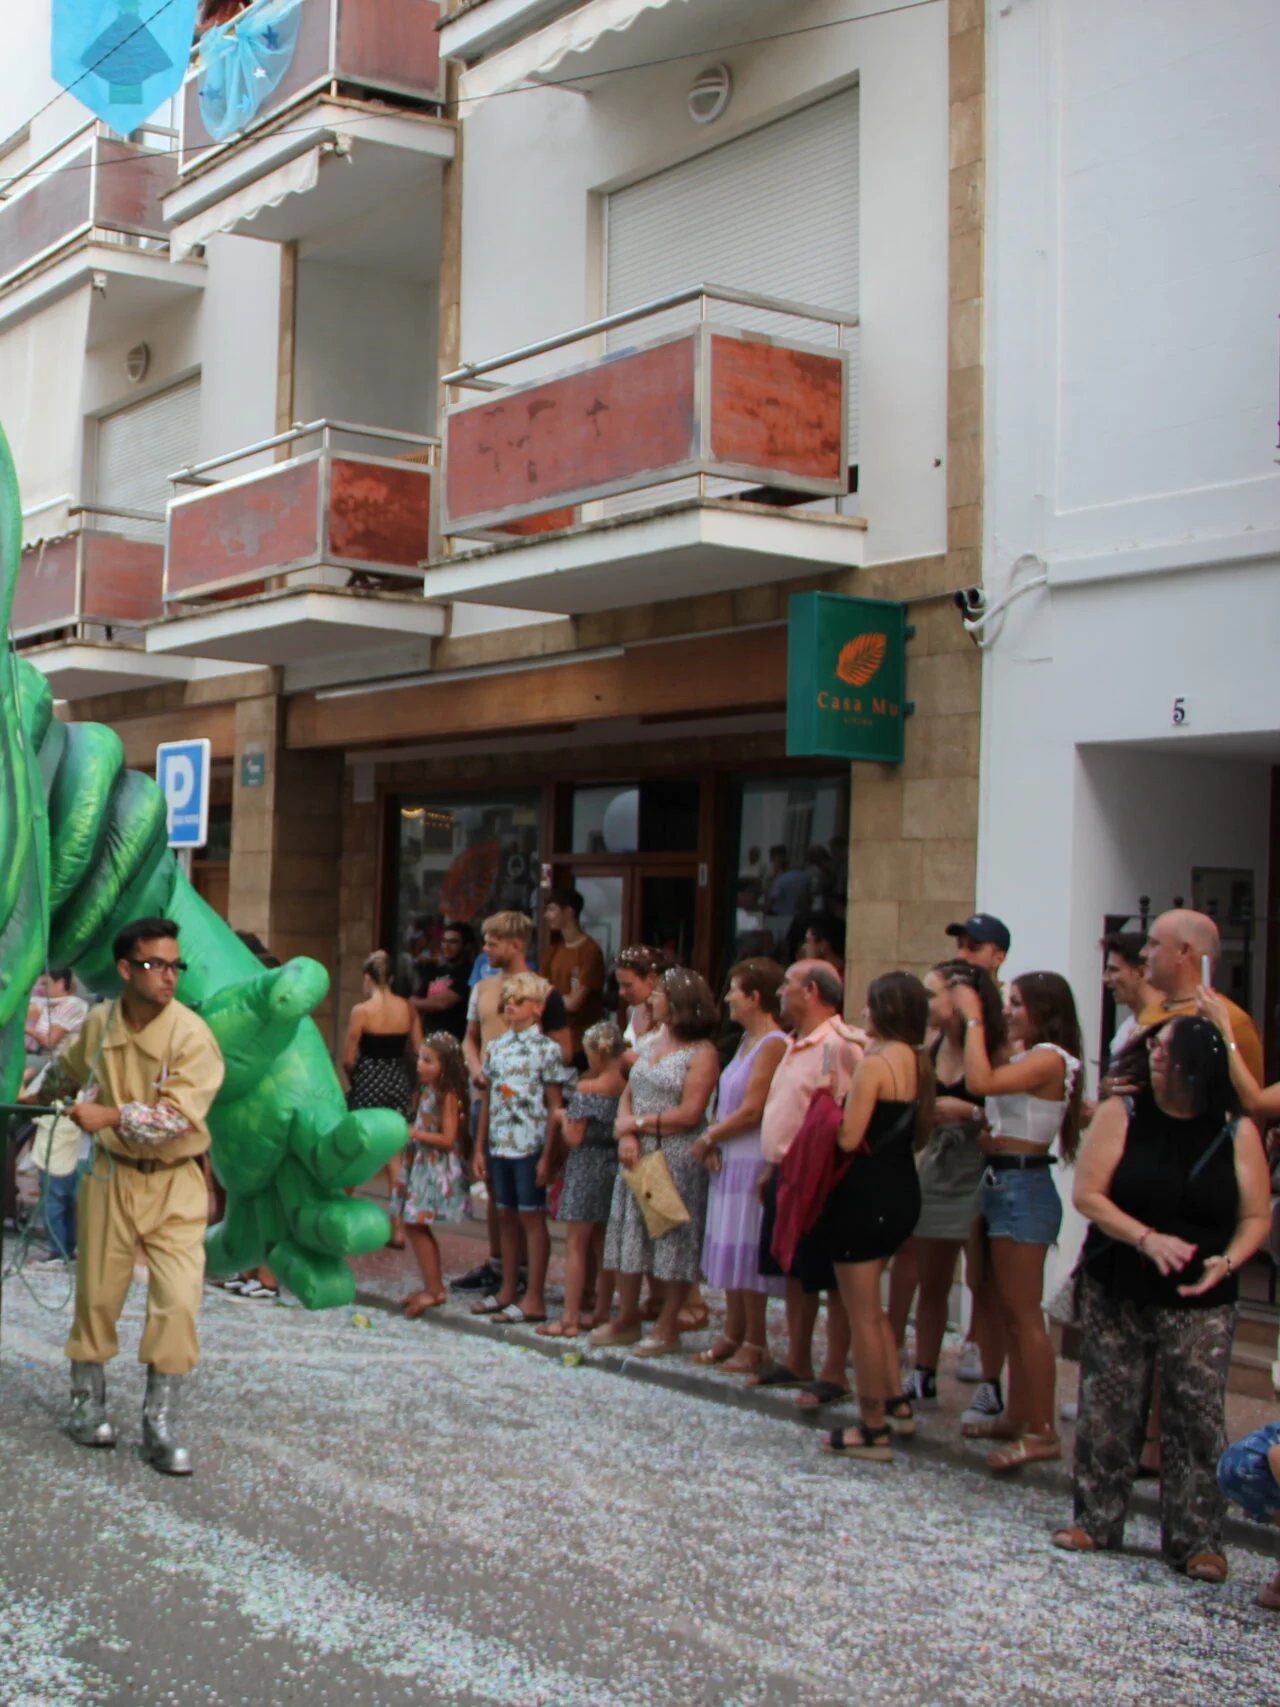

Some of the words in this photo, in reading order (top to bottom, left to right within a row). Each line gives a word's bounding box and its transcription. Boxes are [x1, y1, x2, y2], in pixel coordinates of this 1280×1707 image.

[817, 690, 862, 713] Casa
[1173, 698, 1185, 724] 5
[165, 754, 195, 834] P
